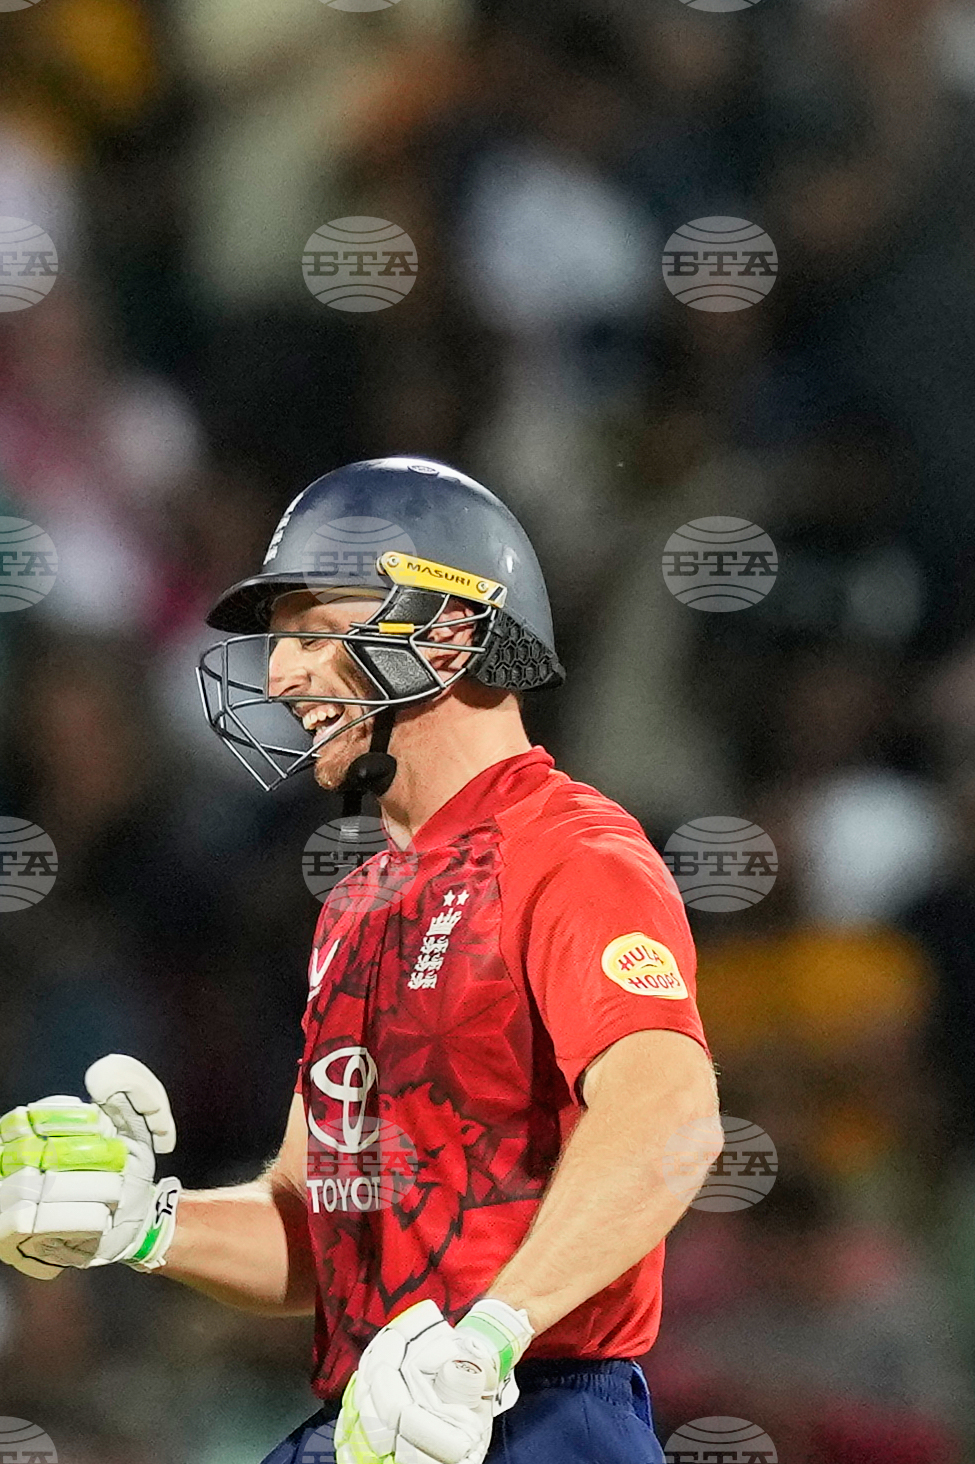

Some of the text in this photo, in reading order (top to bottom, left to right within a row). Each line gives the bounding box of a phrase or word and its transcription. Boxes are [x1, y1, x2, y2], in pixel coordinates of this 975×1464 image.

[406, 562, 471, 587] MASURI
[618, 944, 664, 971] HULA
[628, 972, 680, 989] HOOPS
[306, 1176, 381, 1213] TOYOT
